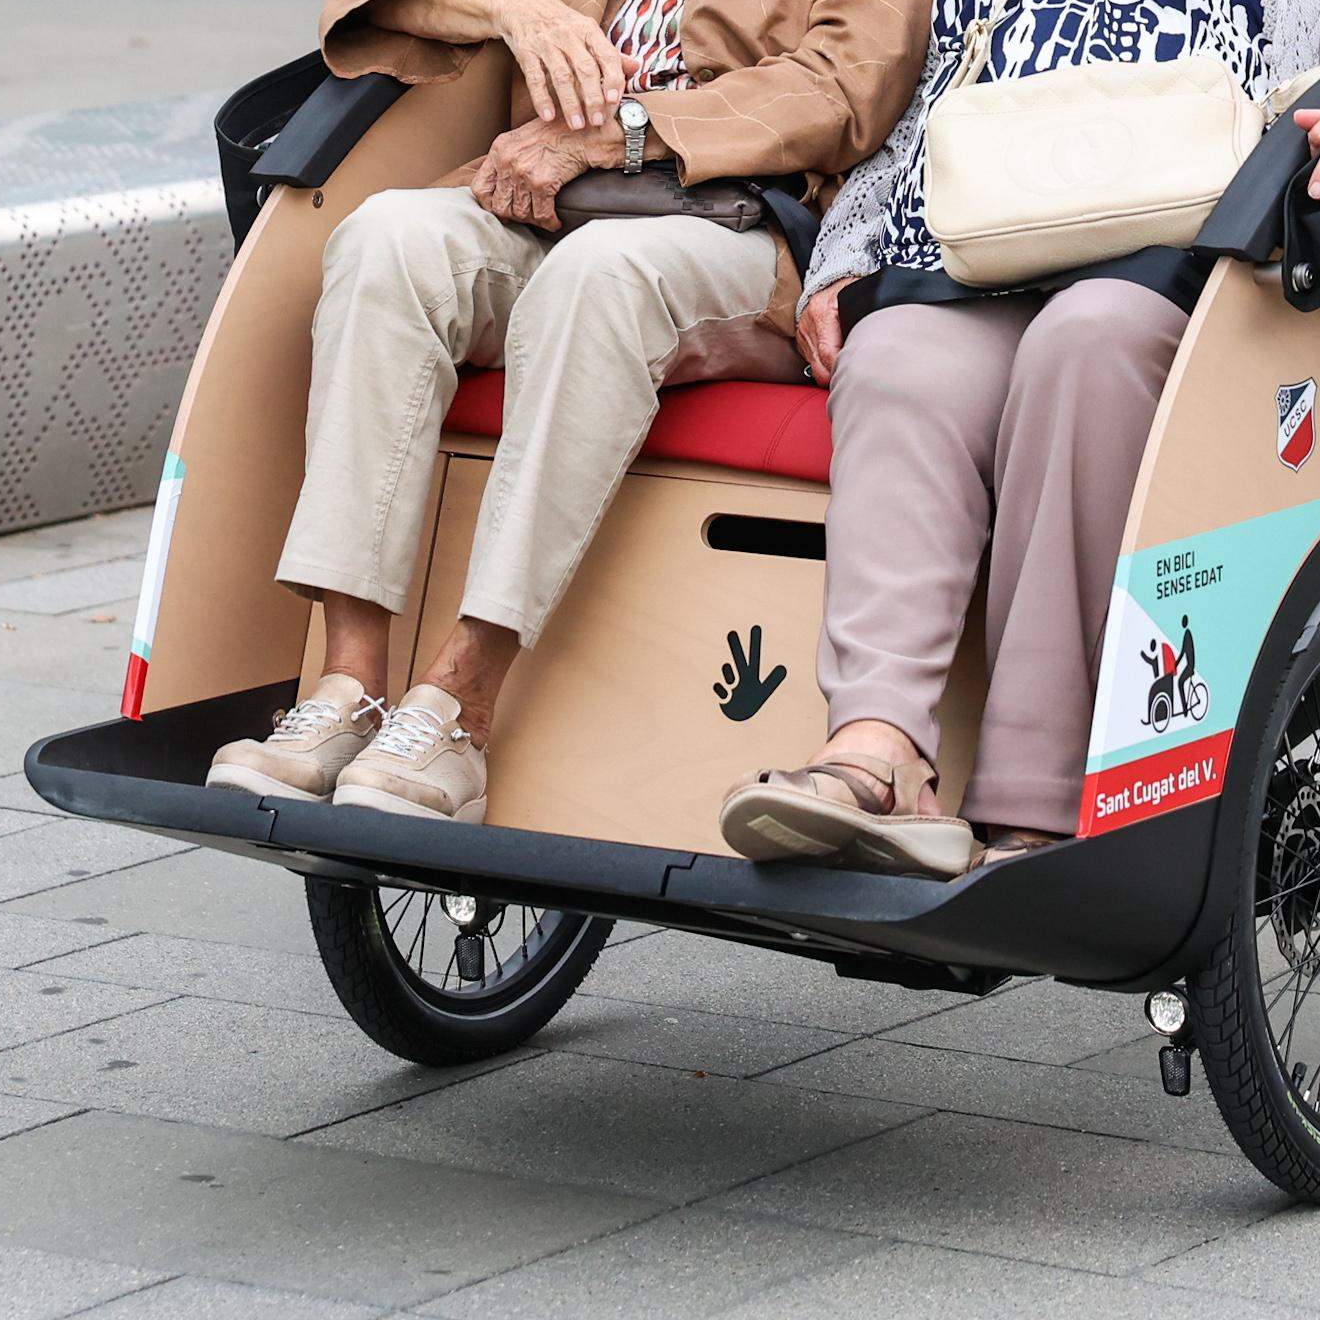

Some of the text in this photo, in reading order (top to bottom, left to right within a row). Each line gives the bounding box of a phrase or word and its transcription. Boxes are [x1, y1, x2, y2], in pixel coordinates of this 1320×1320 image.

[1283, 398, 1307, 437] UCSC
[1156, 550, 1195, 578] EN BICI
[1156, 564, 1224, 600] SENSE EDAT
[1096, 757, 1217, 818] Sant Cugat del V.
